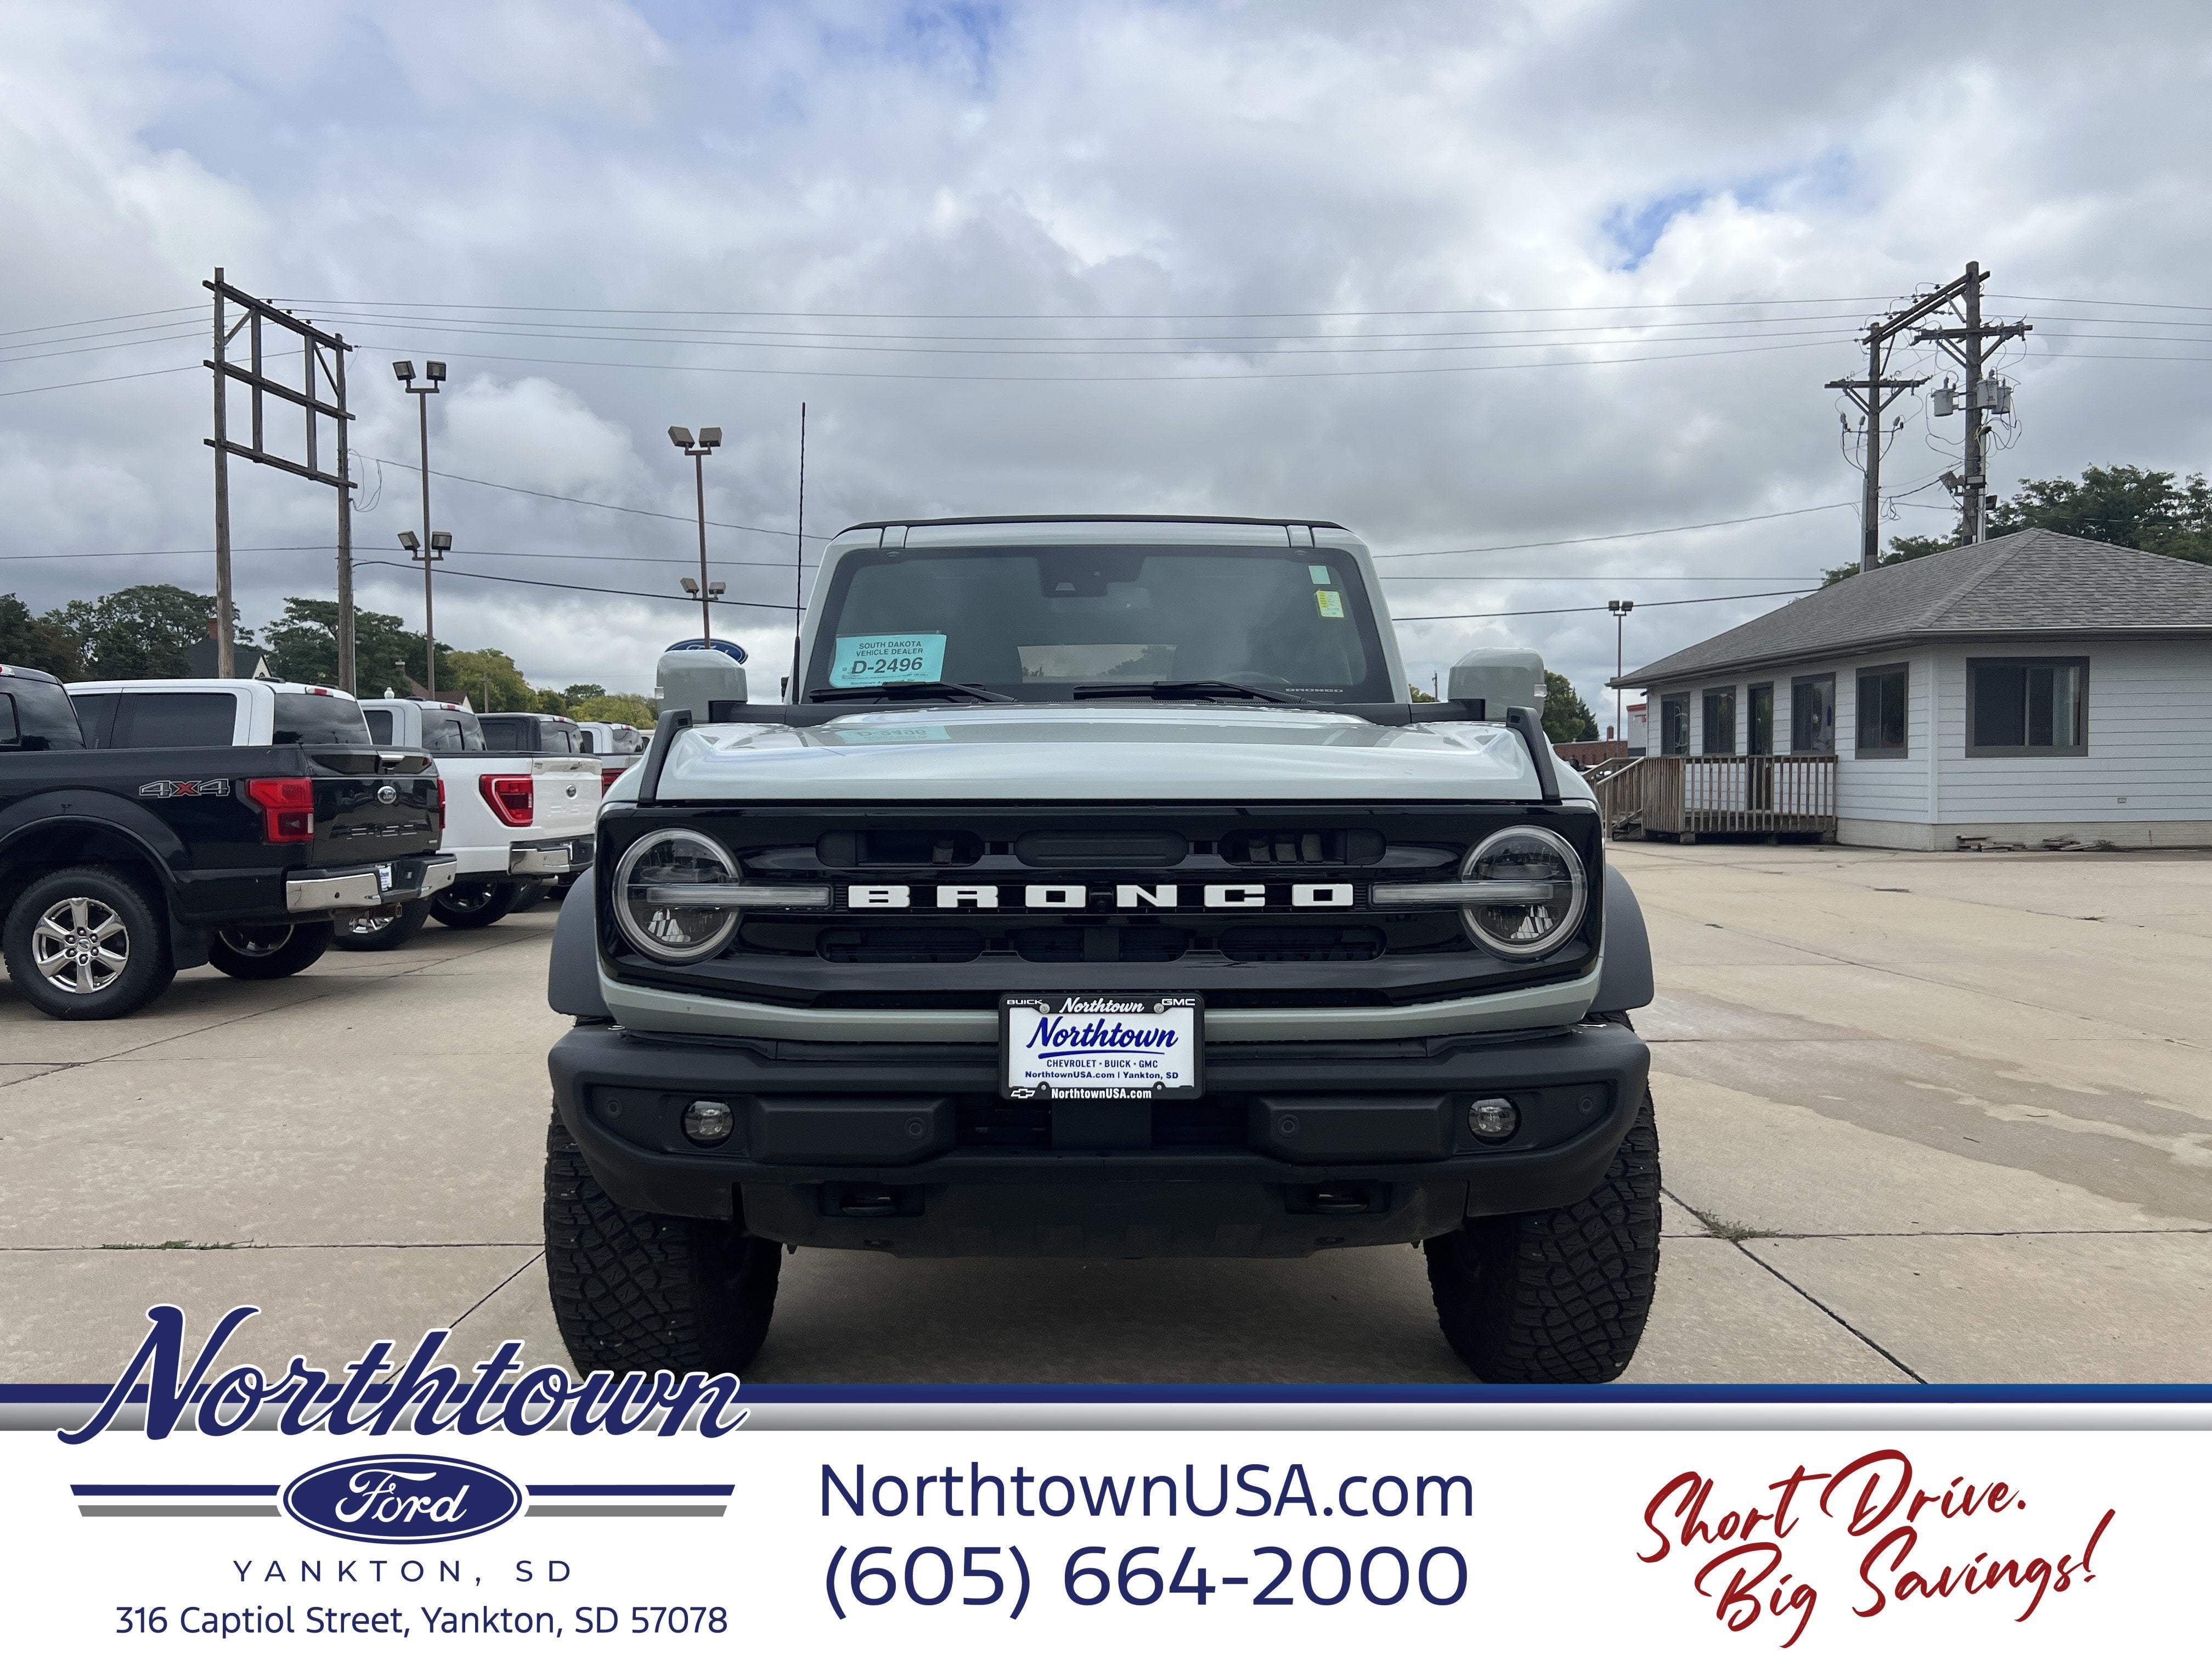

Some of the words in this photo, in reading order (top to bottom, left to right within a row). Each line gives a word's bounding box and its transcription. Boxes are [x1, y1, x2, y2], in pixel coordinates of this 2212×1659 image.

[856, 648, 889, 657] VEHICLE
[851, 657, 923, 674] D-2496
[848, 884, 1353, 909] BRONCO
[1059, 997, 1145, 1013] Northtown
[1026, 1015, 1178, 1048] Northtown
[1047, 1059, 1096, 1068] CHEVROLET
[1104, 1059, 1131, 1068] BUICK
[1139, 1059, 1158, 1068] GMC
[1123, 1071, 1163, 1080] Yankton,
[1051, 1088, 1152, 1098] NorthtownUSA.com
